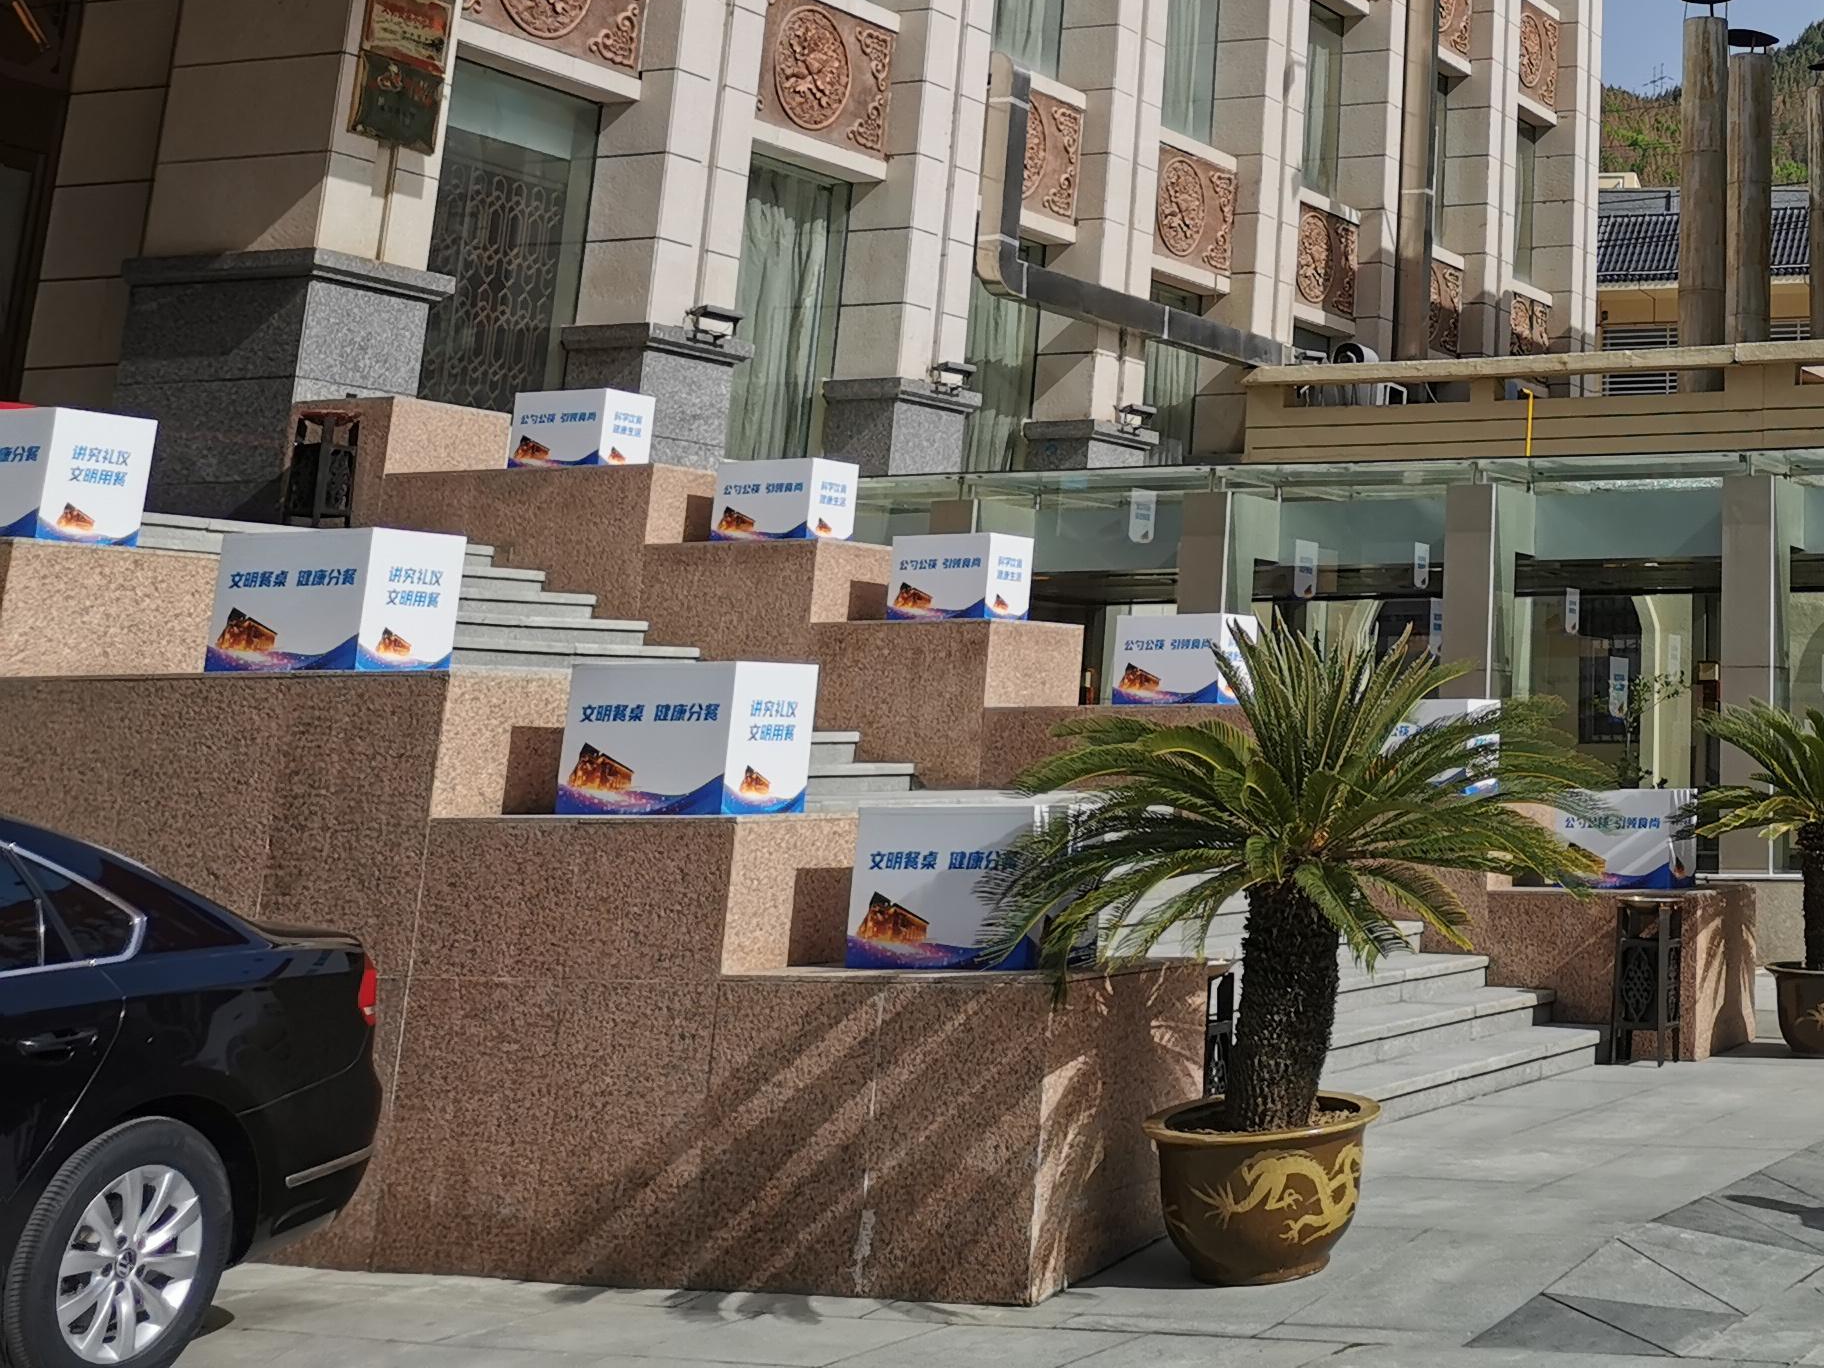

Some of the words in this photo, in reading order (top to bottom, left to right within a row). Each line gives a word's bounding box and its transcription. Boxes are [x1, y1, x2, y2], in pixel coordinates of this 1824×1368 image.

[72, 444, 131, 466] 讲究礼仪
[69, 467, 128, 487] 文明用餐
[228, 570, 289, 589] 文明餐桌
[296, 568, 358, 587] 健康分餐
[388, 566, 444, 586] 讲究礼仪
[386, 588, 442, 608] 文明用餐
[579, 704, 645, 722] 文明餐桌
[653, 702, 720, 722] 健康分餐
[750, 699, 799, 718] 讲究礼仪
[748, 723, 796, 742] 文明用餐
[869, 850, 939, 871] 文明餐桌
